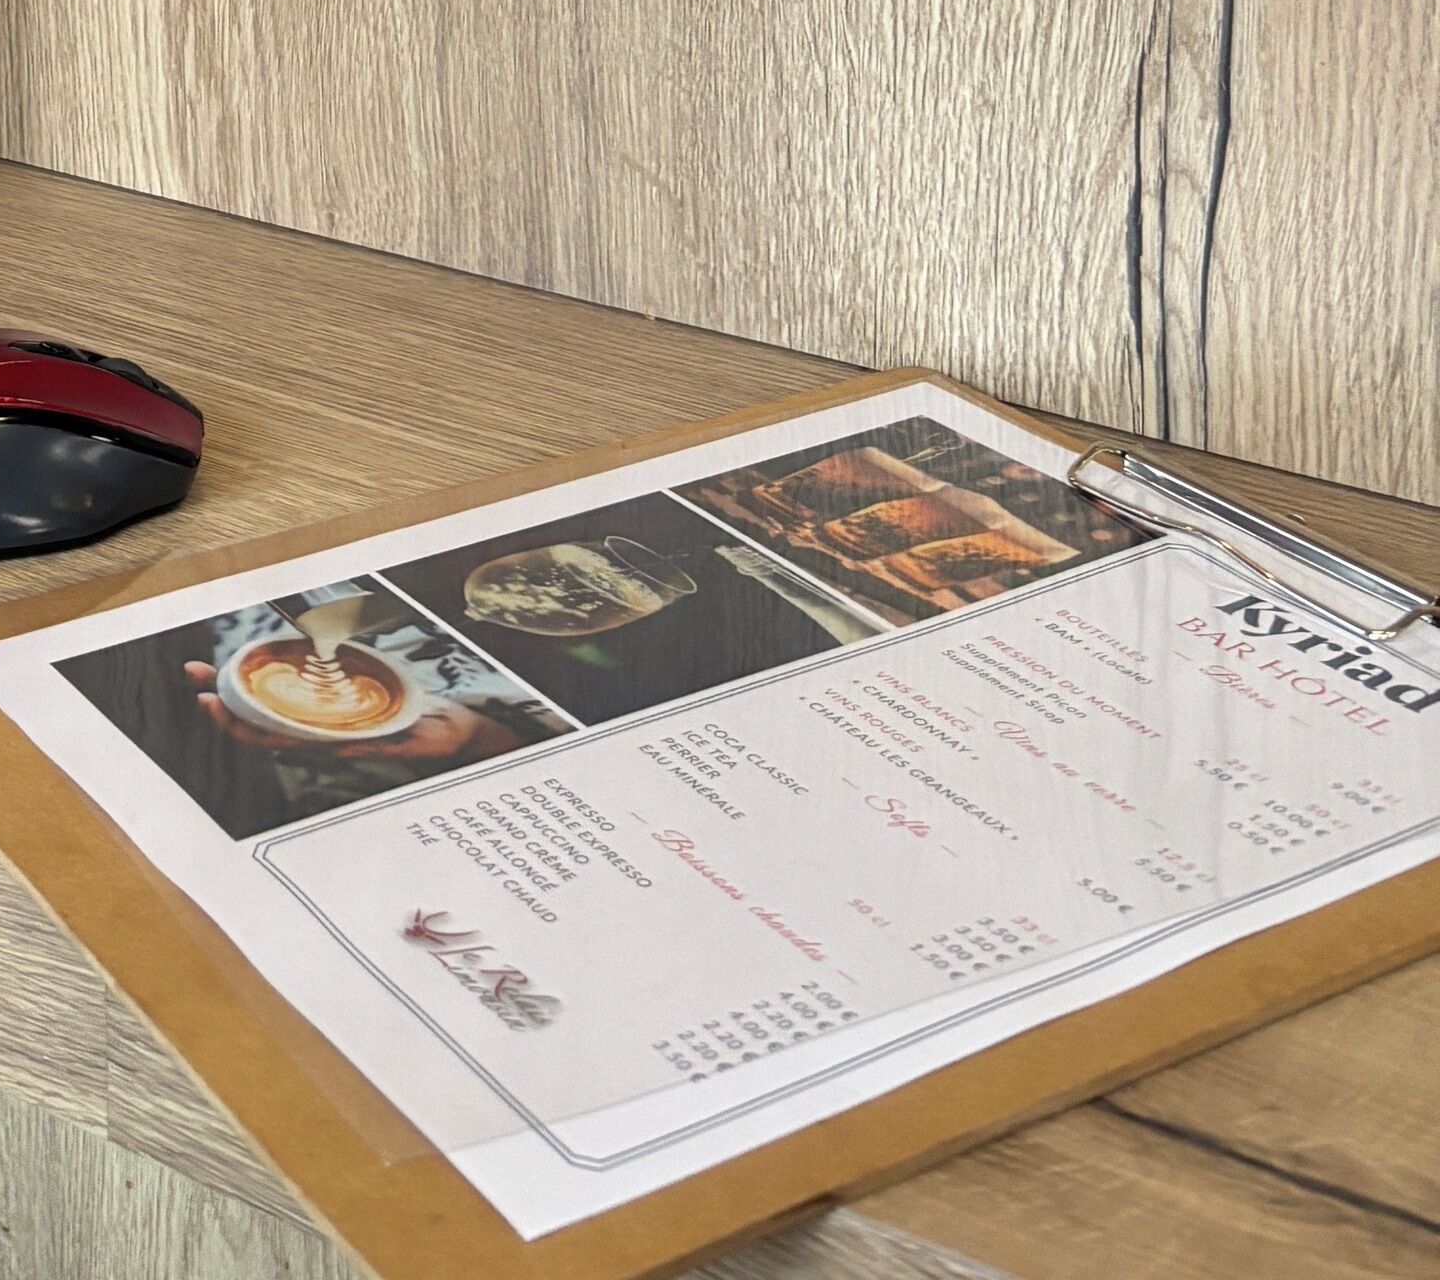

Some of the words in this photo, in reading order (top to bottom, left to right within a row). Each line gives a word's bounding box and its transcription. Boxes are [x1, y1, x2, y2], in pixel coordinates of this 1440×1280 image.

[1043, 622, 1082, 646] BAM
[1091, 650, 1153, 685] (Locale)
[1056, 608, 1149, 663] BOUTEILLES
[1214, 594, 1440, 713] Kyriad
[941, 649, 1025, 701] Supplément
[982, 634, 1058, 681] PRESSION
[1058, 679, 1085, 695] DU
[1085, 696, 1163, 740] MOMENT
[1175, 616, 1256, 660] BAR
[1257, 658, 1393, 736] HÔTEL
[824, 687, 861, 712] VINS
[859, 711, 926, 754] ROUGES
[862, 685, 972, 754] CHARDONNAY
[876, 670, 912, 694] VINS
[911, 694, 974, 734] BLANCS
[1045, 692, 1088, 719] Picon
[659, 736, 722, 780] PERRIER
[682, 729, 709, 751] ICE
[709, 748, 738, 770] TEA
[703, 723, 747, 754] COCA
[746, 752, 811, 796] CLASSIC
[993, 720, 1048, 759] Vins
[638, 744, 673, 766] EAU
[669, 766, 747, 822] MINÉRALE
[878, 748, 910, 768] LES
[908, 768, 1012, 835] GRANGEAUX
[1194, 758, 1234, 782] 5.50
[476, 800, 527, 841] GRAND
[499, 792, 590, 866] CAPPUCCINO
[543, 778, 616, 832] EXPRESSO
[1263, 799, 1315, 829] 10.00
[406, 821, 441, 847] THÉ
[452, 807, 494, 838] CAFÉ
[487, 838, 560, 893] ALLONGÉ
[520, 785, 581, 830] DOUBLE
[578, 830, 652, 889] EXPRESSO
[428, 814, 507, 879] CHOCOLAT
[503, 878, 559, 924] CHAUD
[650, 829, 744, 901] Boissons
[1077, 878, 1119, 903] 5.00
[1134, 858, 1176, 883] 5.50
[909, 942, 951, 969] 1.50
[931, 934, 974, 961] 3.00
[976, 917, 1020, 944] 3.50
[779, 991, 818, 1020] 4.00
[801, 981, 842, 1009] 2.00
[651, 1040, 693, 1071] 3.50
